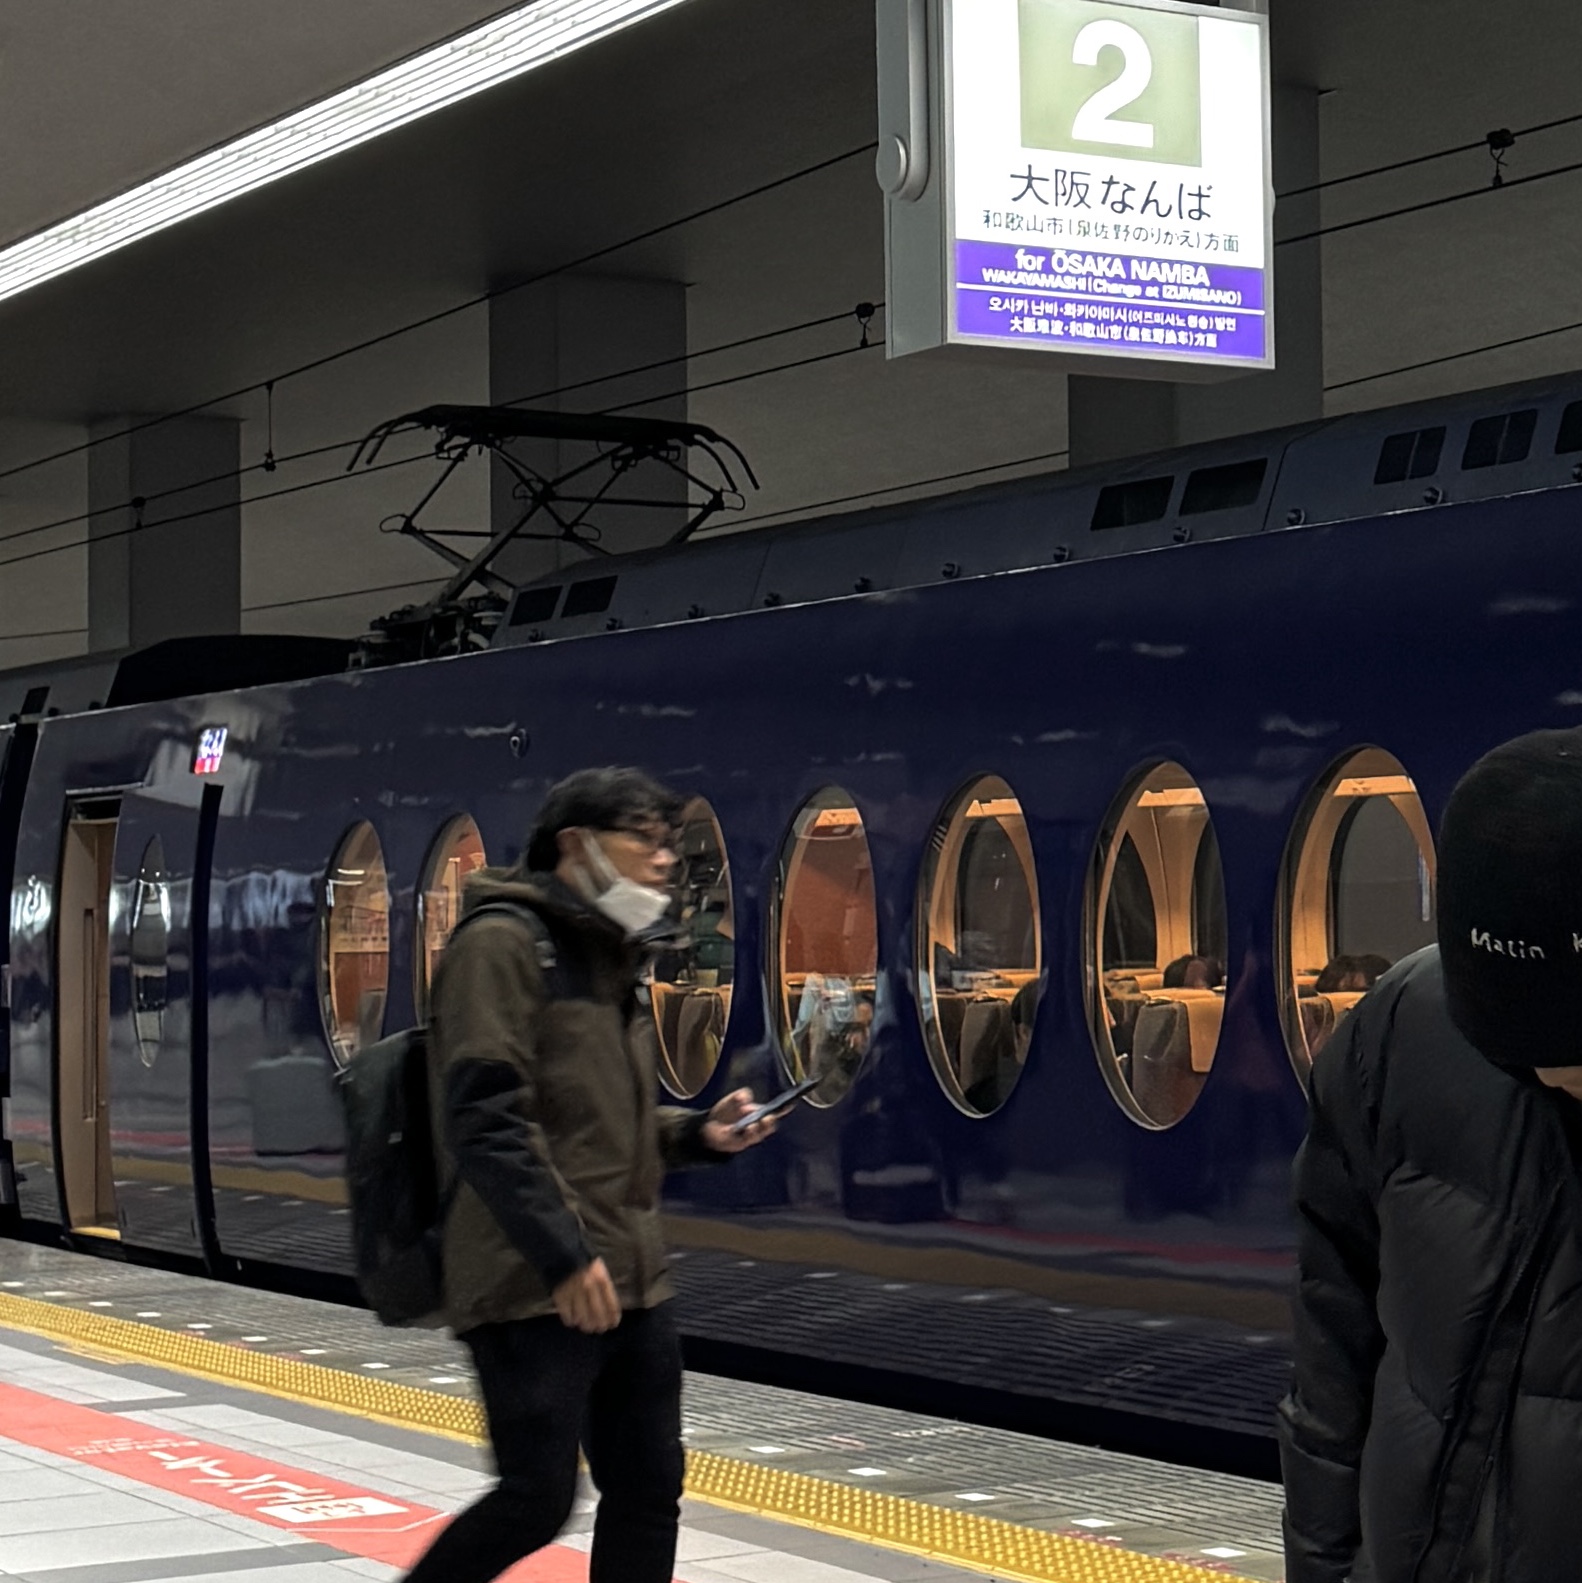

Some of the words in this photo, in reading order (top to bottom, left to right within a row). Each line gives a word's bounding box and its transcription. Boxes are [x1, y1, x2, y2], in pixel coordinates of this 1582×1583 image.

[1071, 19, 1154, 149] 2
[1010, 164, 1213, 221] 大阪なんば
[1015, 249, 1046, 271] for
[1131, 259, 1210, 287] NAMBA
